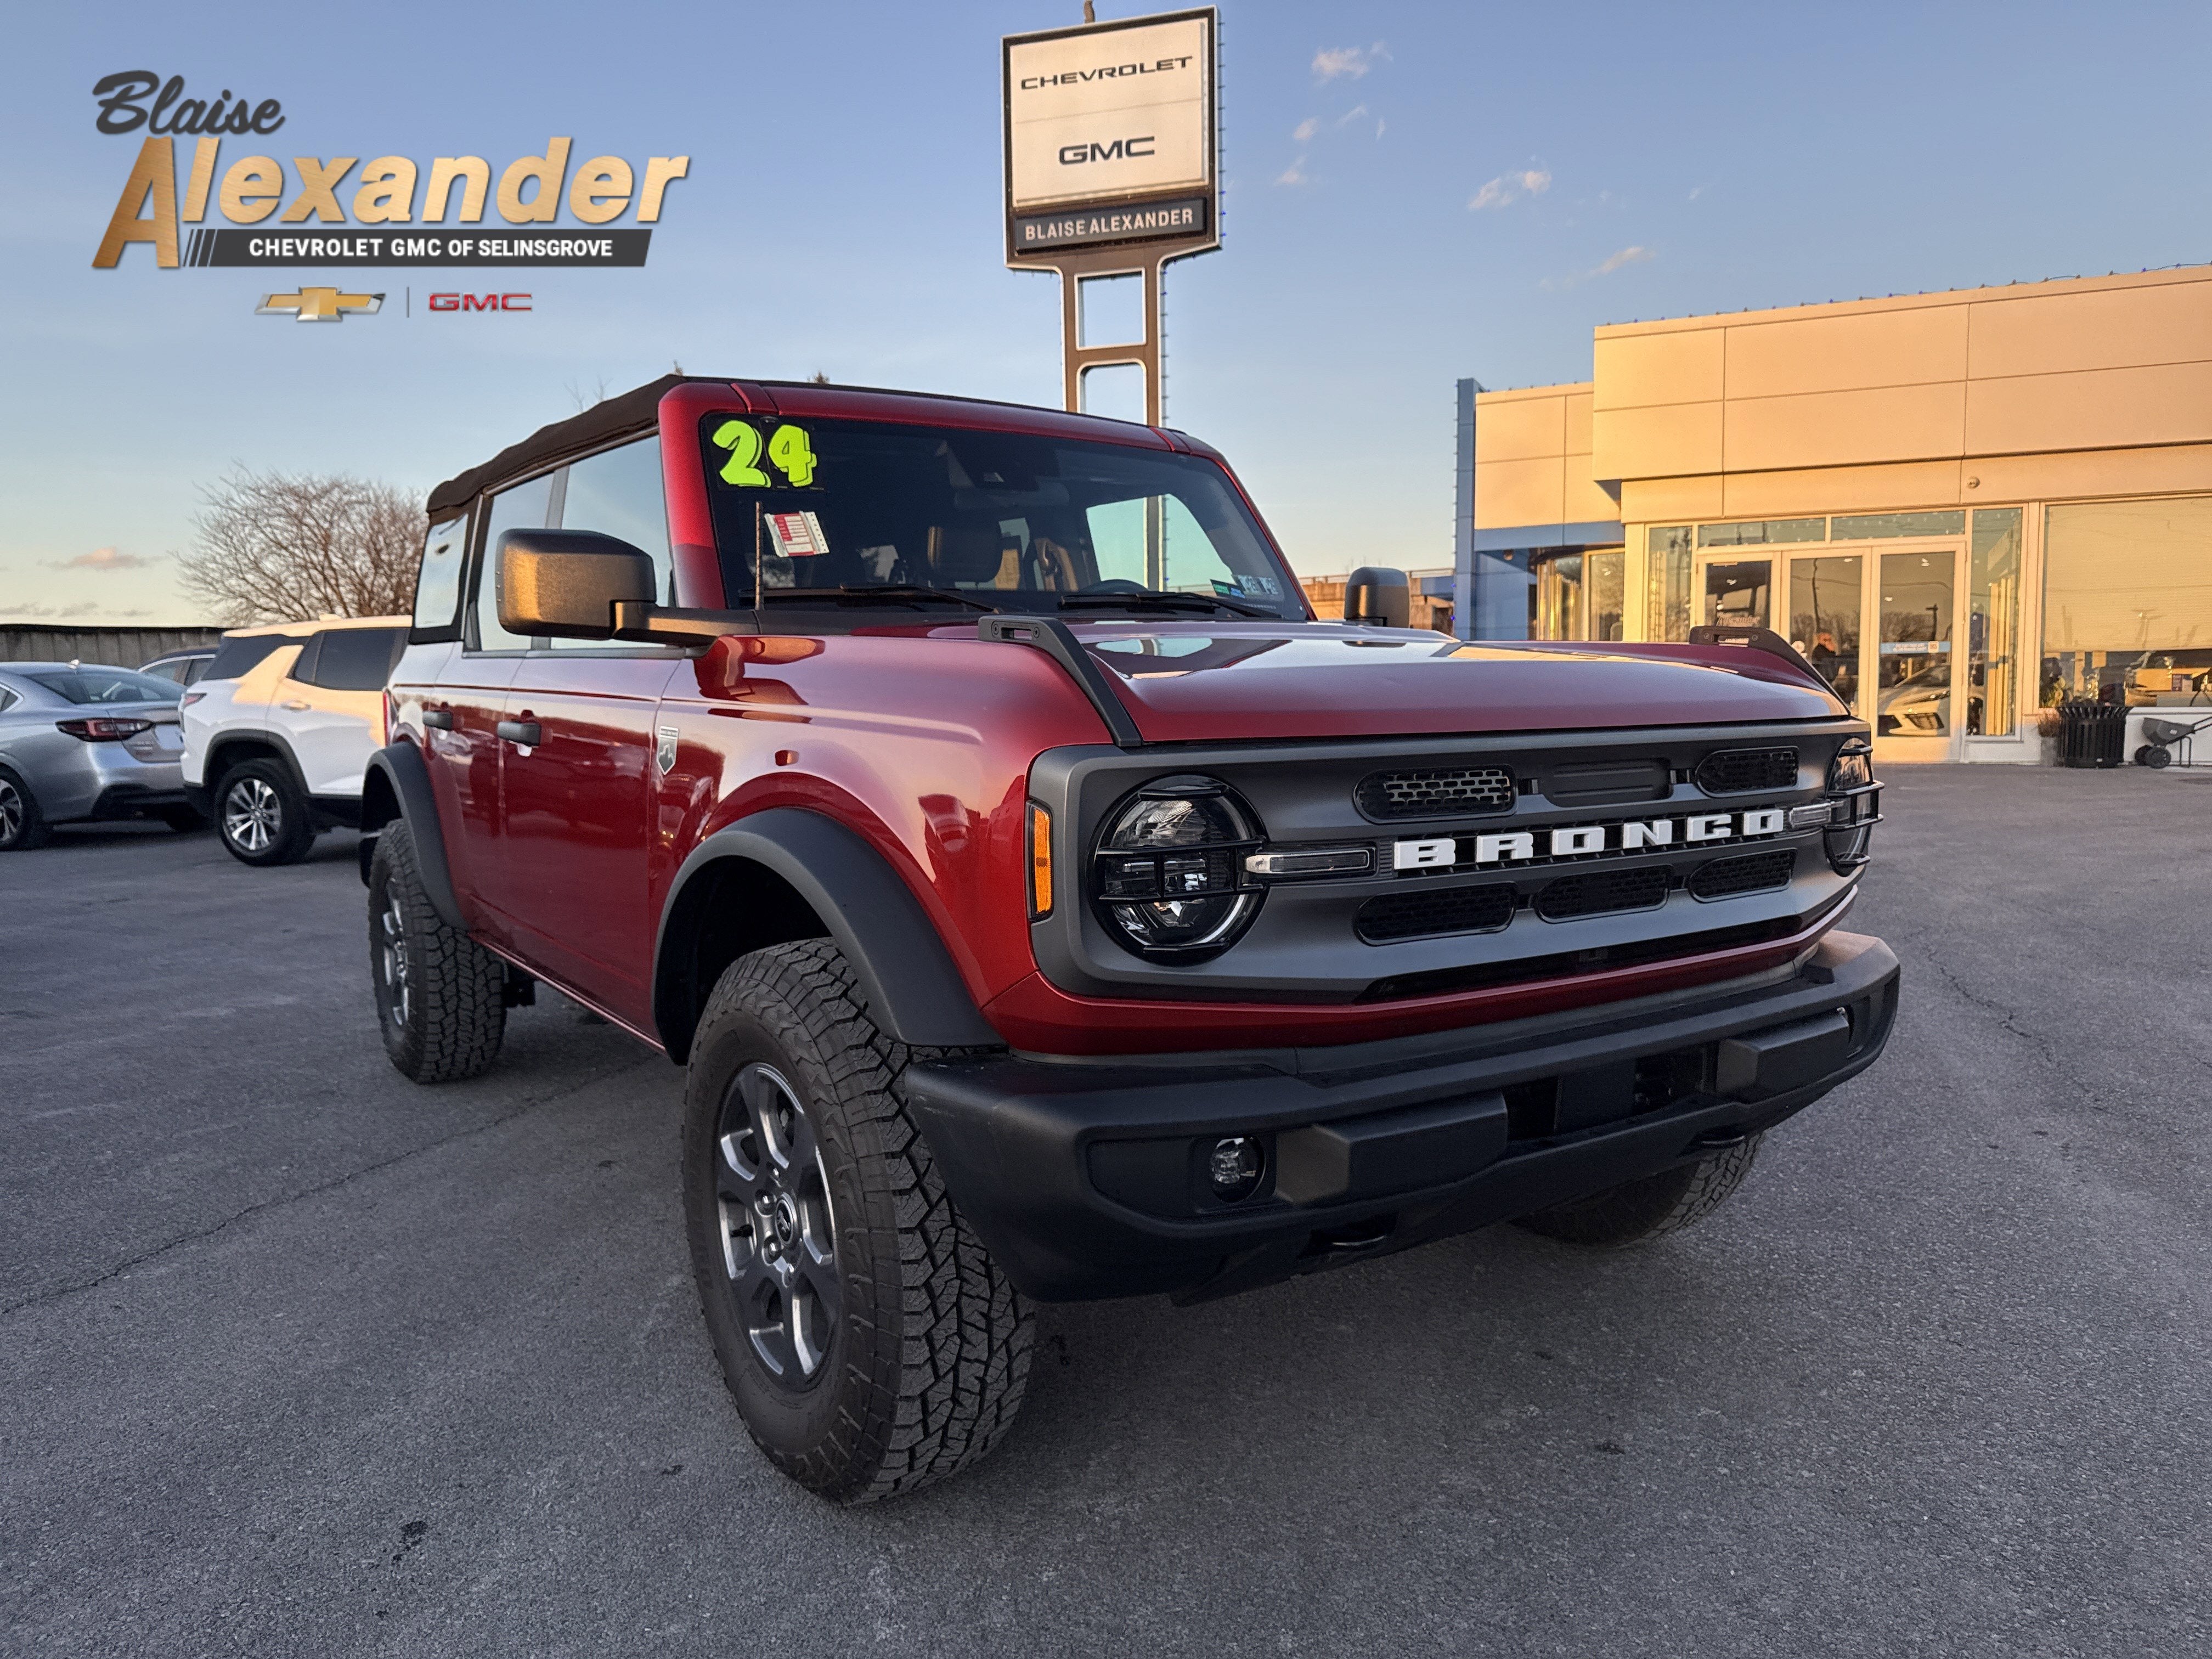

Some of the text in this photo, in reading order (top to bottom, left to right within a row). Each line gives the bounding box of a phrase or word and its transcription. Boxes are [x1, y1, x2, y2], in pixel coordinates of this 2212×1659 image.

[1021, 56, 1193, 90] CHEVROLET
[1059, 136, 1155, 165] GMC
[1025, 208, 1193, 240] BLAISE ALEXANDER
[713, 420, 817, 488] 24
[1393, 808, 1784, 870] BRONCO
